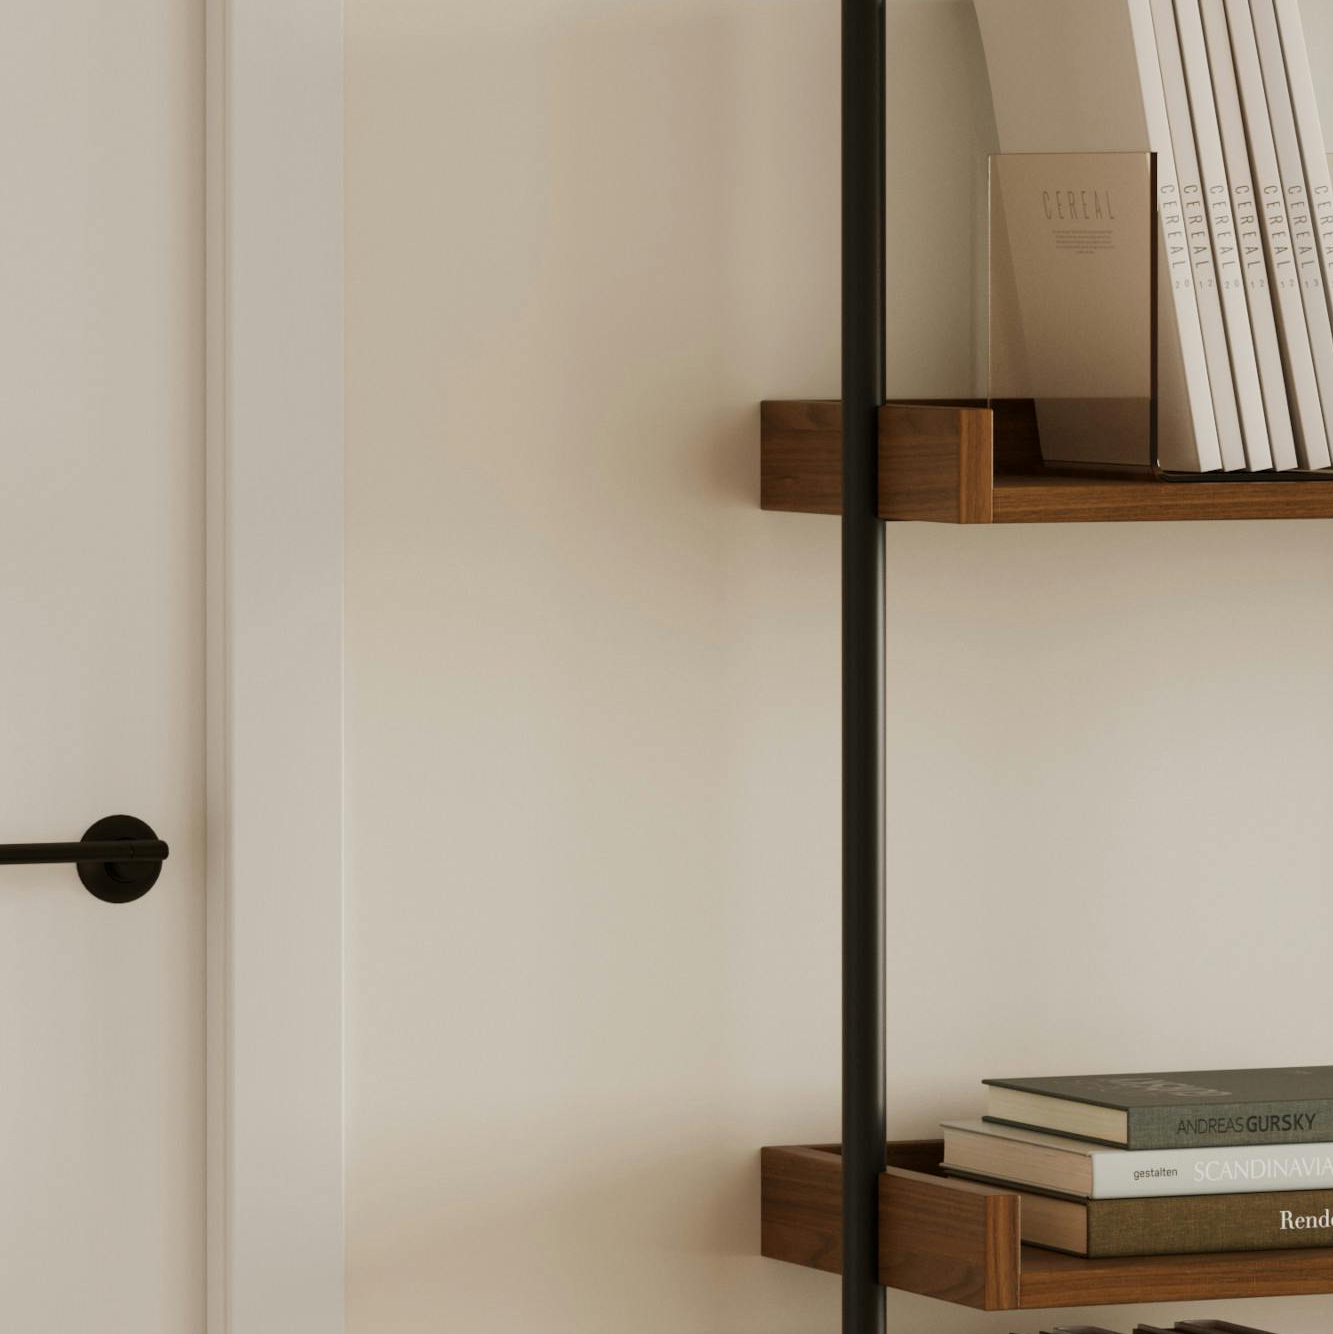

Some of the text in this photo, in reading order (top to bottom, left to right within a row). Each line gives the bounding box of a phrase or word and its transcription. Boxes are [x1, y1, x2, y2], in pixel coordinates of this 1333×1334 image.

[1042, 190, 1116, 220] CEREAL
[1160, 184, 1186, 269] CEREAL
[1183, 184, 1209, 269] CEREAL
[1209, 184, 1236, 269] CEREAL
[1234, 184, 1261, 269] CEREAL
[1263, 184, 1291, 269] CEREAL
[1287, 184, 1315, 269] CEREAL
[1245, 1112, 1317, 1133] GURSKY
[1133, 1167, 1178, 1181] gestalten
